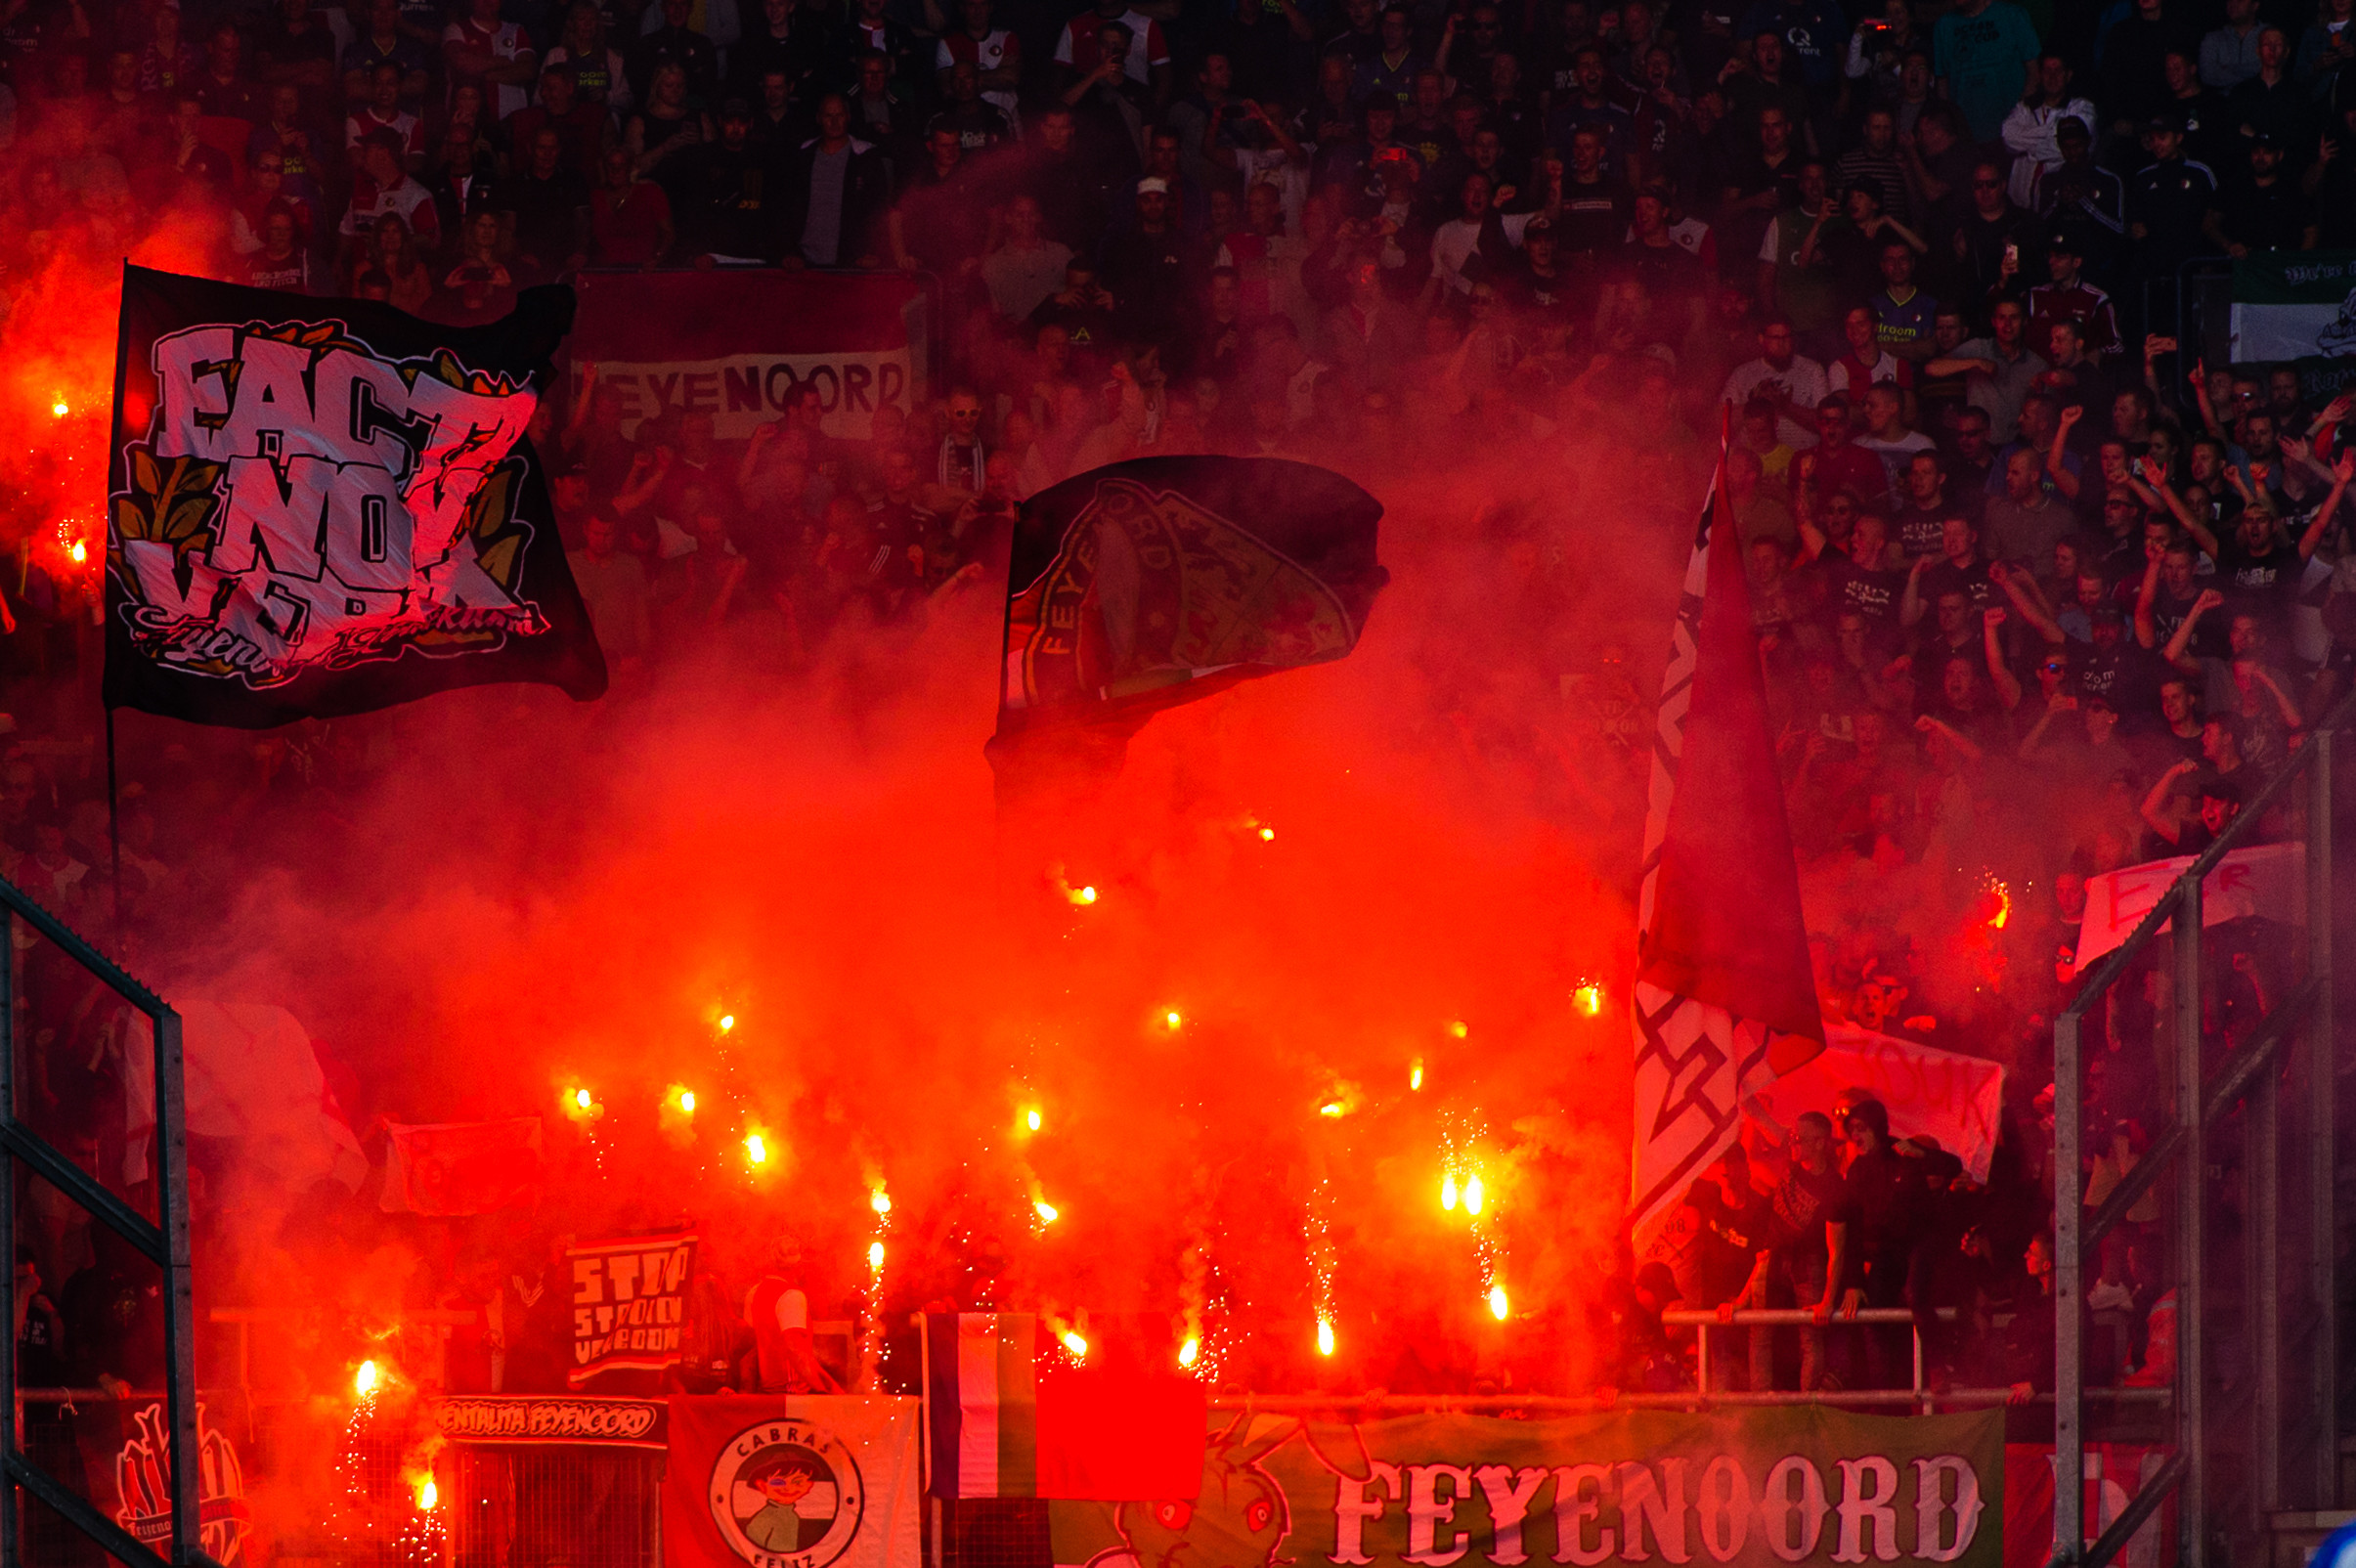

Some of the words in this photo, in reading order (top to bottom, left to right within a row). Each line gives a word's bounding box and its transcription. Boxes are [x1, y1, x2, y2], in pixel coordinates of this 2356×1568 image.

[570, 362, 904, 420] EYENOORD
[574, 1246, 690, 1305] STOP
[530, 1405, 651, 1434] FEYENOORD
[1325, 1454, 1987, 1566] FEYENOORD
